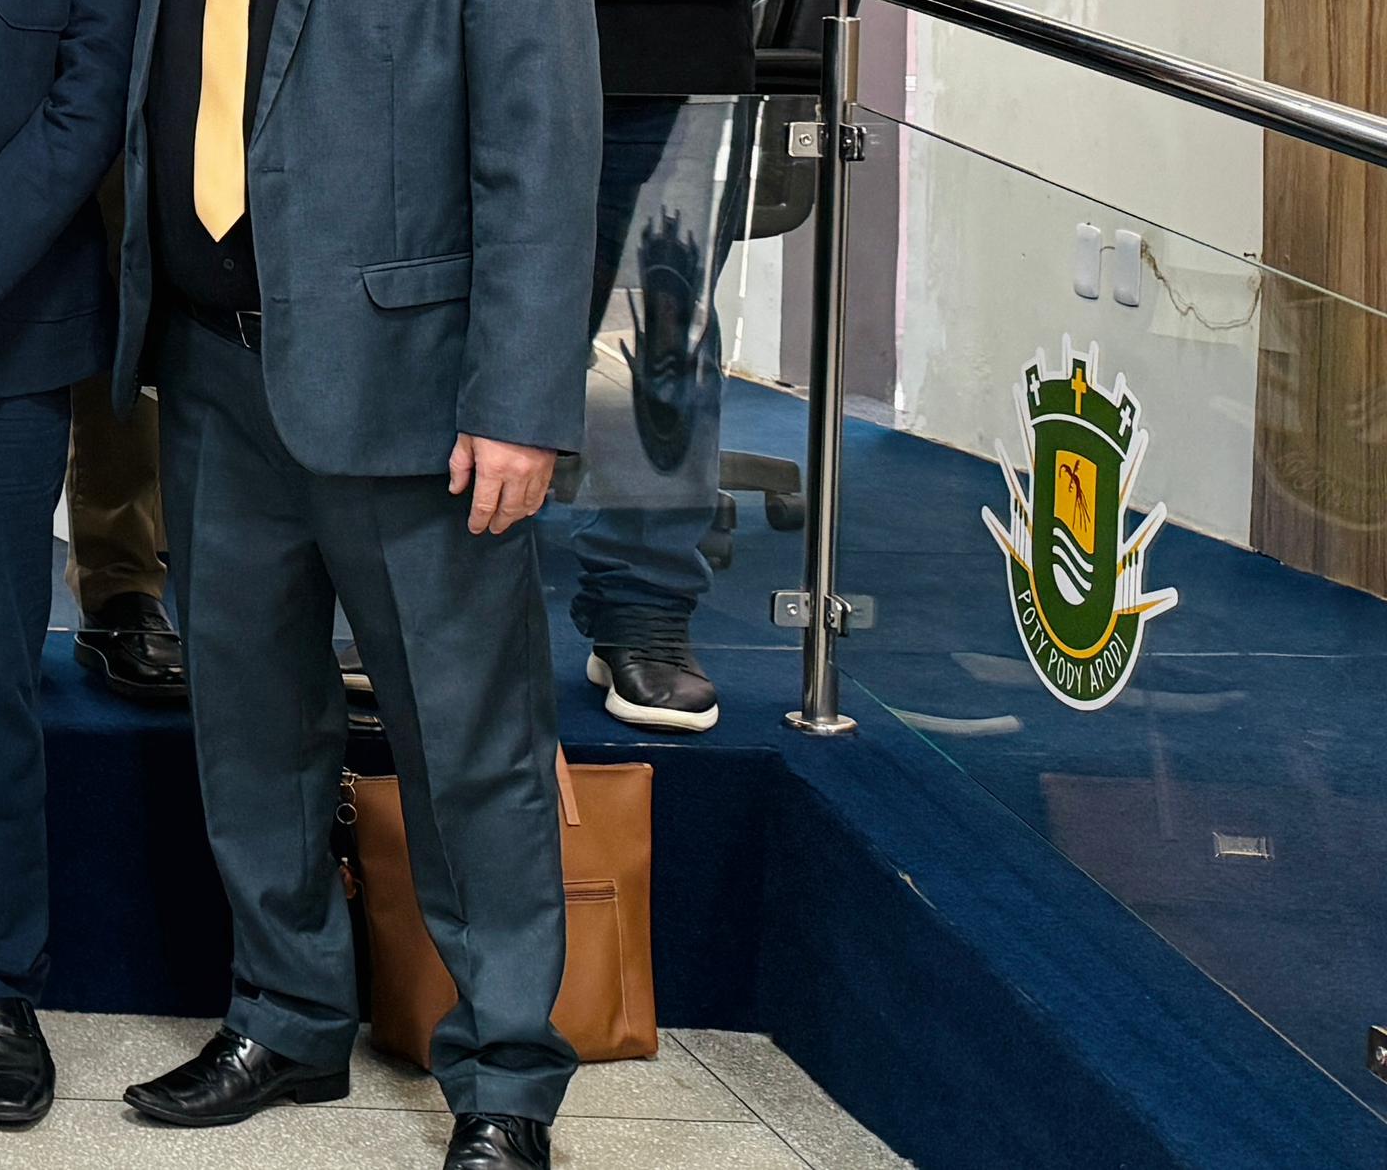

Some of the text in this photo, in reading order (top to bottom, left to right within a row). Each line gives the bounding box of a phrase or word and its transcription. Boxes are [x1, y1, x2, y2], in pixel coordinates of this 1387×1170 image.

[1018, 590, 1128, 694] POTY PODY APODI
